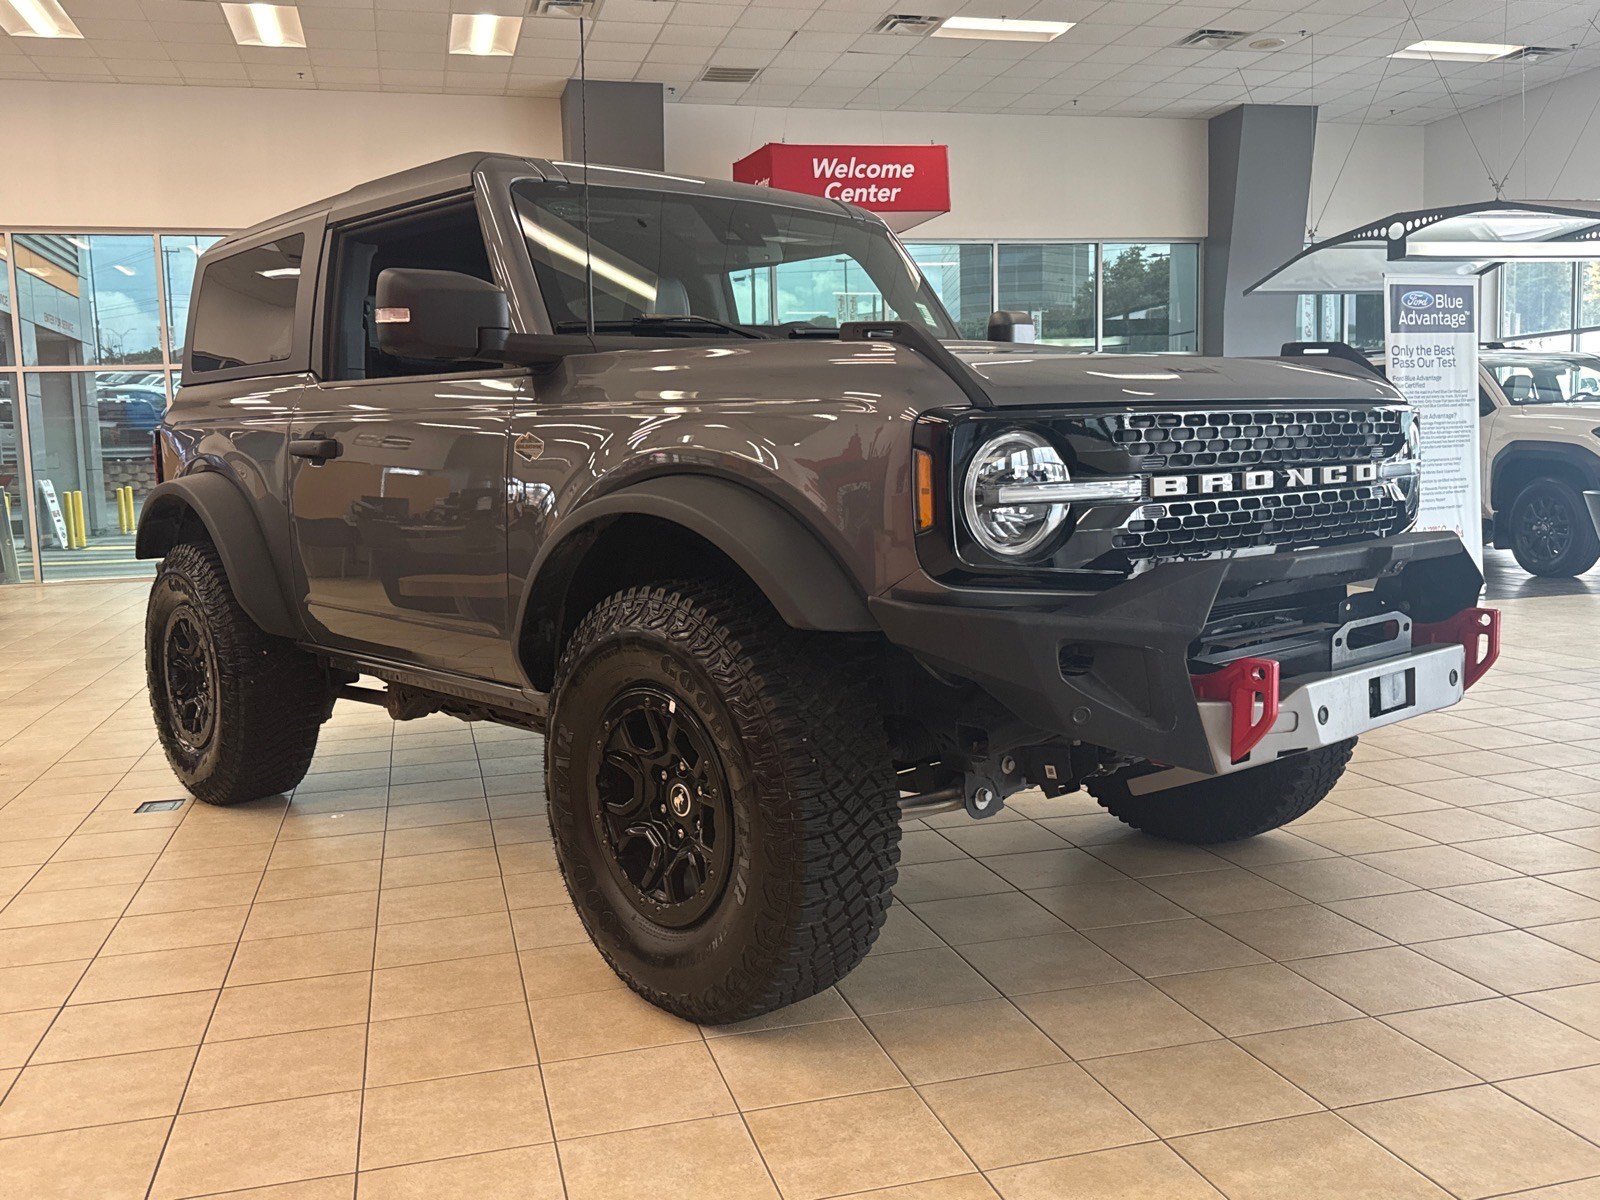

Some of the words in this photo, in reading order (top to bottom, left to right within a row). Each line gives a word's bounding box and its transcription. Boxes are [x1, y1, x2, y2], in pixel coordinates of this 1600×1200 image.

[812, 157, 915, 179] Welcome
[824, 182, 902, 203] Center
[1407, 293, 1429, 306] Ford
[1435, 294, 1463, 309] Blue
[1391, 345, 1414, 358] Only
[1416, 345, 1432, 356] the
[1434, 345, 1455, 356] Best
[1392, 357, 1416, 368] Pass
[1417, 357, 1435, 368] Our
[1436, 357, 1457, 368] Test
[1416, 375, 1442, 383] Advantage
[1150, 463, 1377, 497] BRONCO
